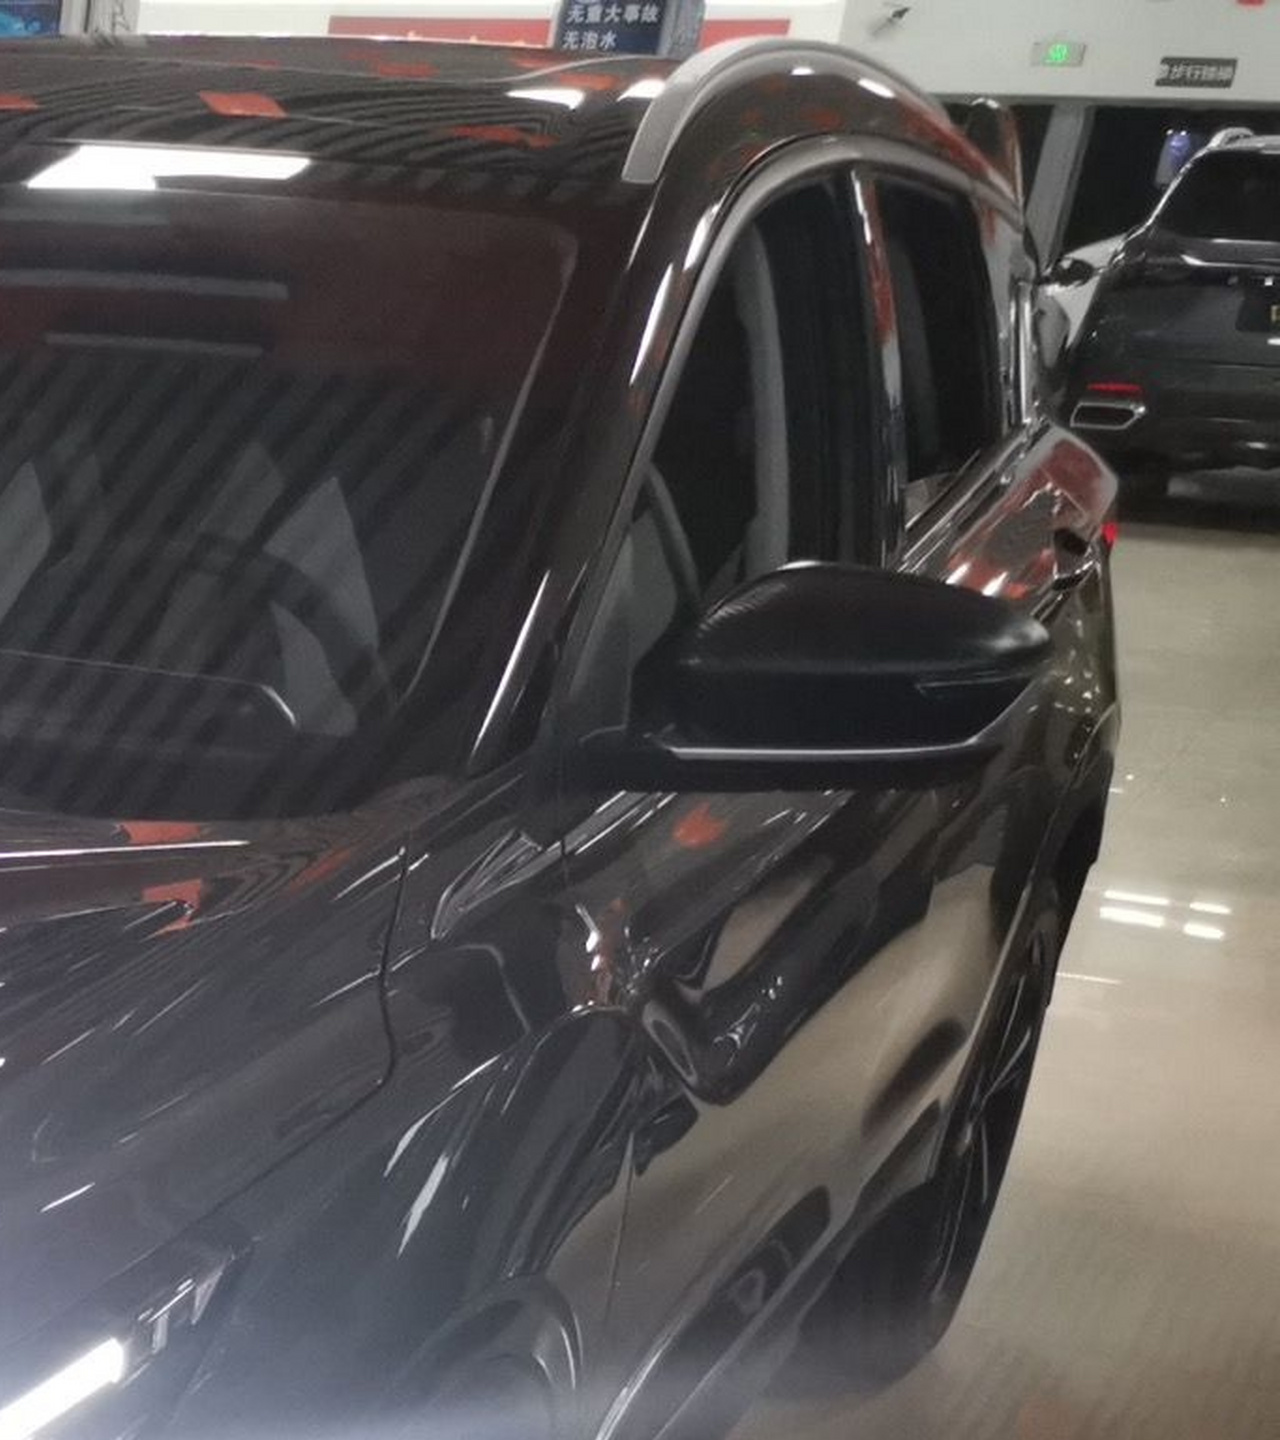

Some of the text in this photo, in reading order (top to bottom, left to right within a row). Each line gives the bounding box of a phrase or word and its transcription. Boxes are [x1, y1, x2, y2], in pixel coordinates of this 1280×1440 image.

[567, 4, 659, 23] 无重大事故
[563, 30, 618, 50] 无泡水
